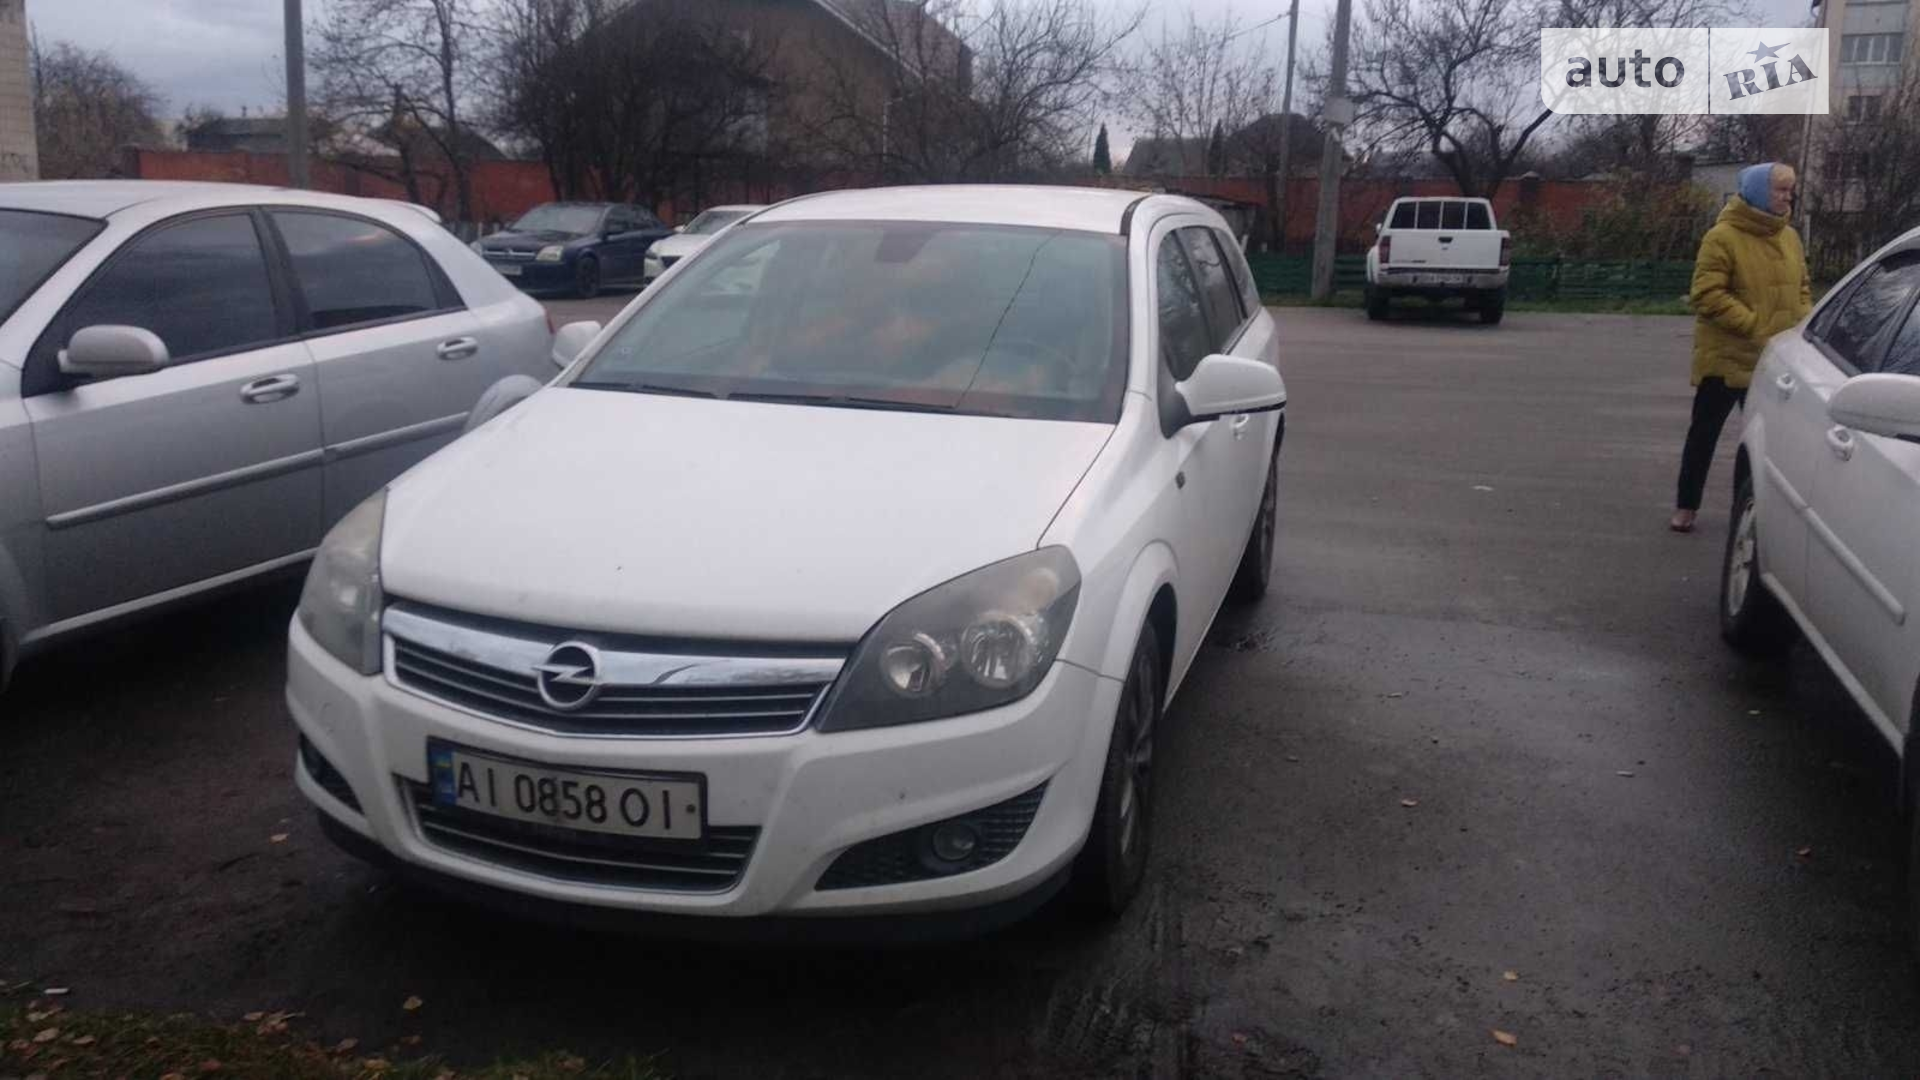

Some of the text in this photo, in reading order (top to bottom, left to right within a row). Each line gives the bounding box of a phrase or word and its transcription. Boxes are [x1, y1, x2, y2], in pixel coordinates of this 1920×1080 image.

[457, 762, 497, 807] AI
[514, 774, 607, 823] 0858
[620, 788, 671, 830] OI
